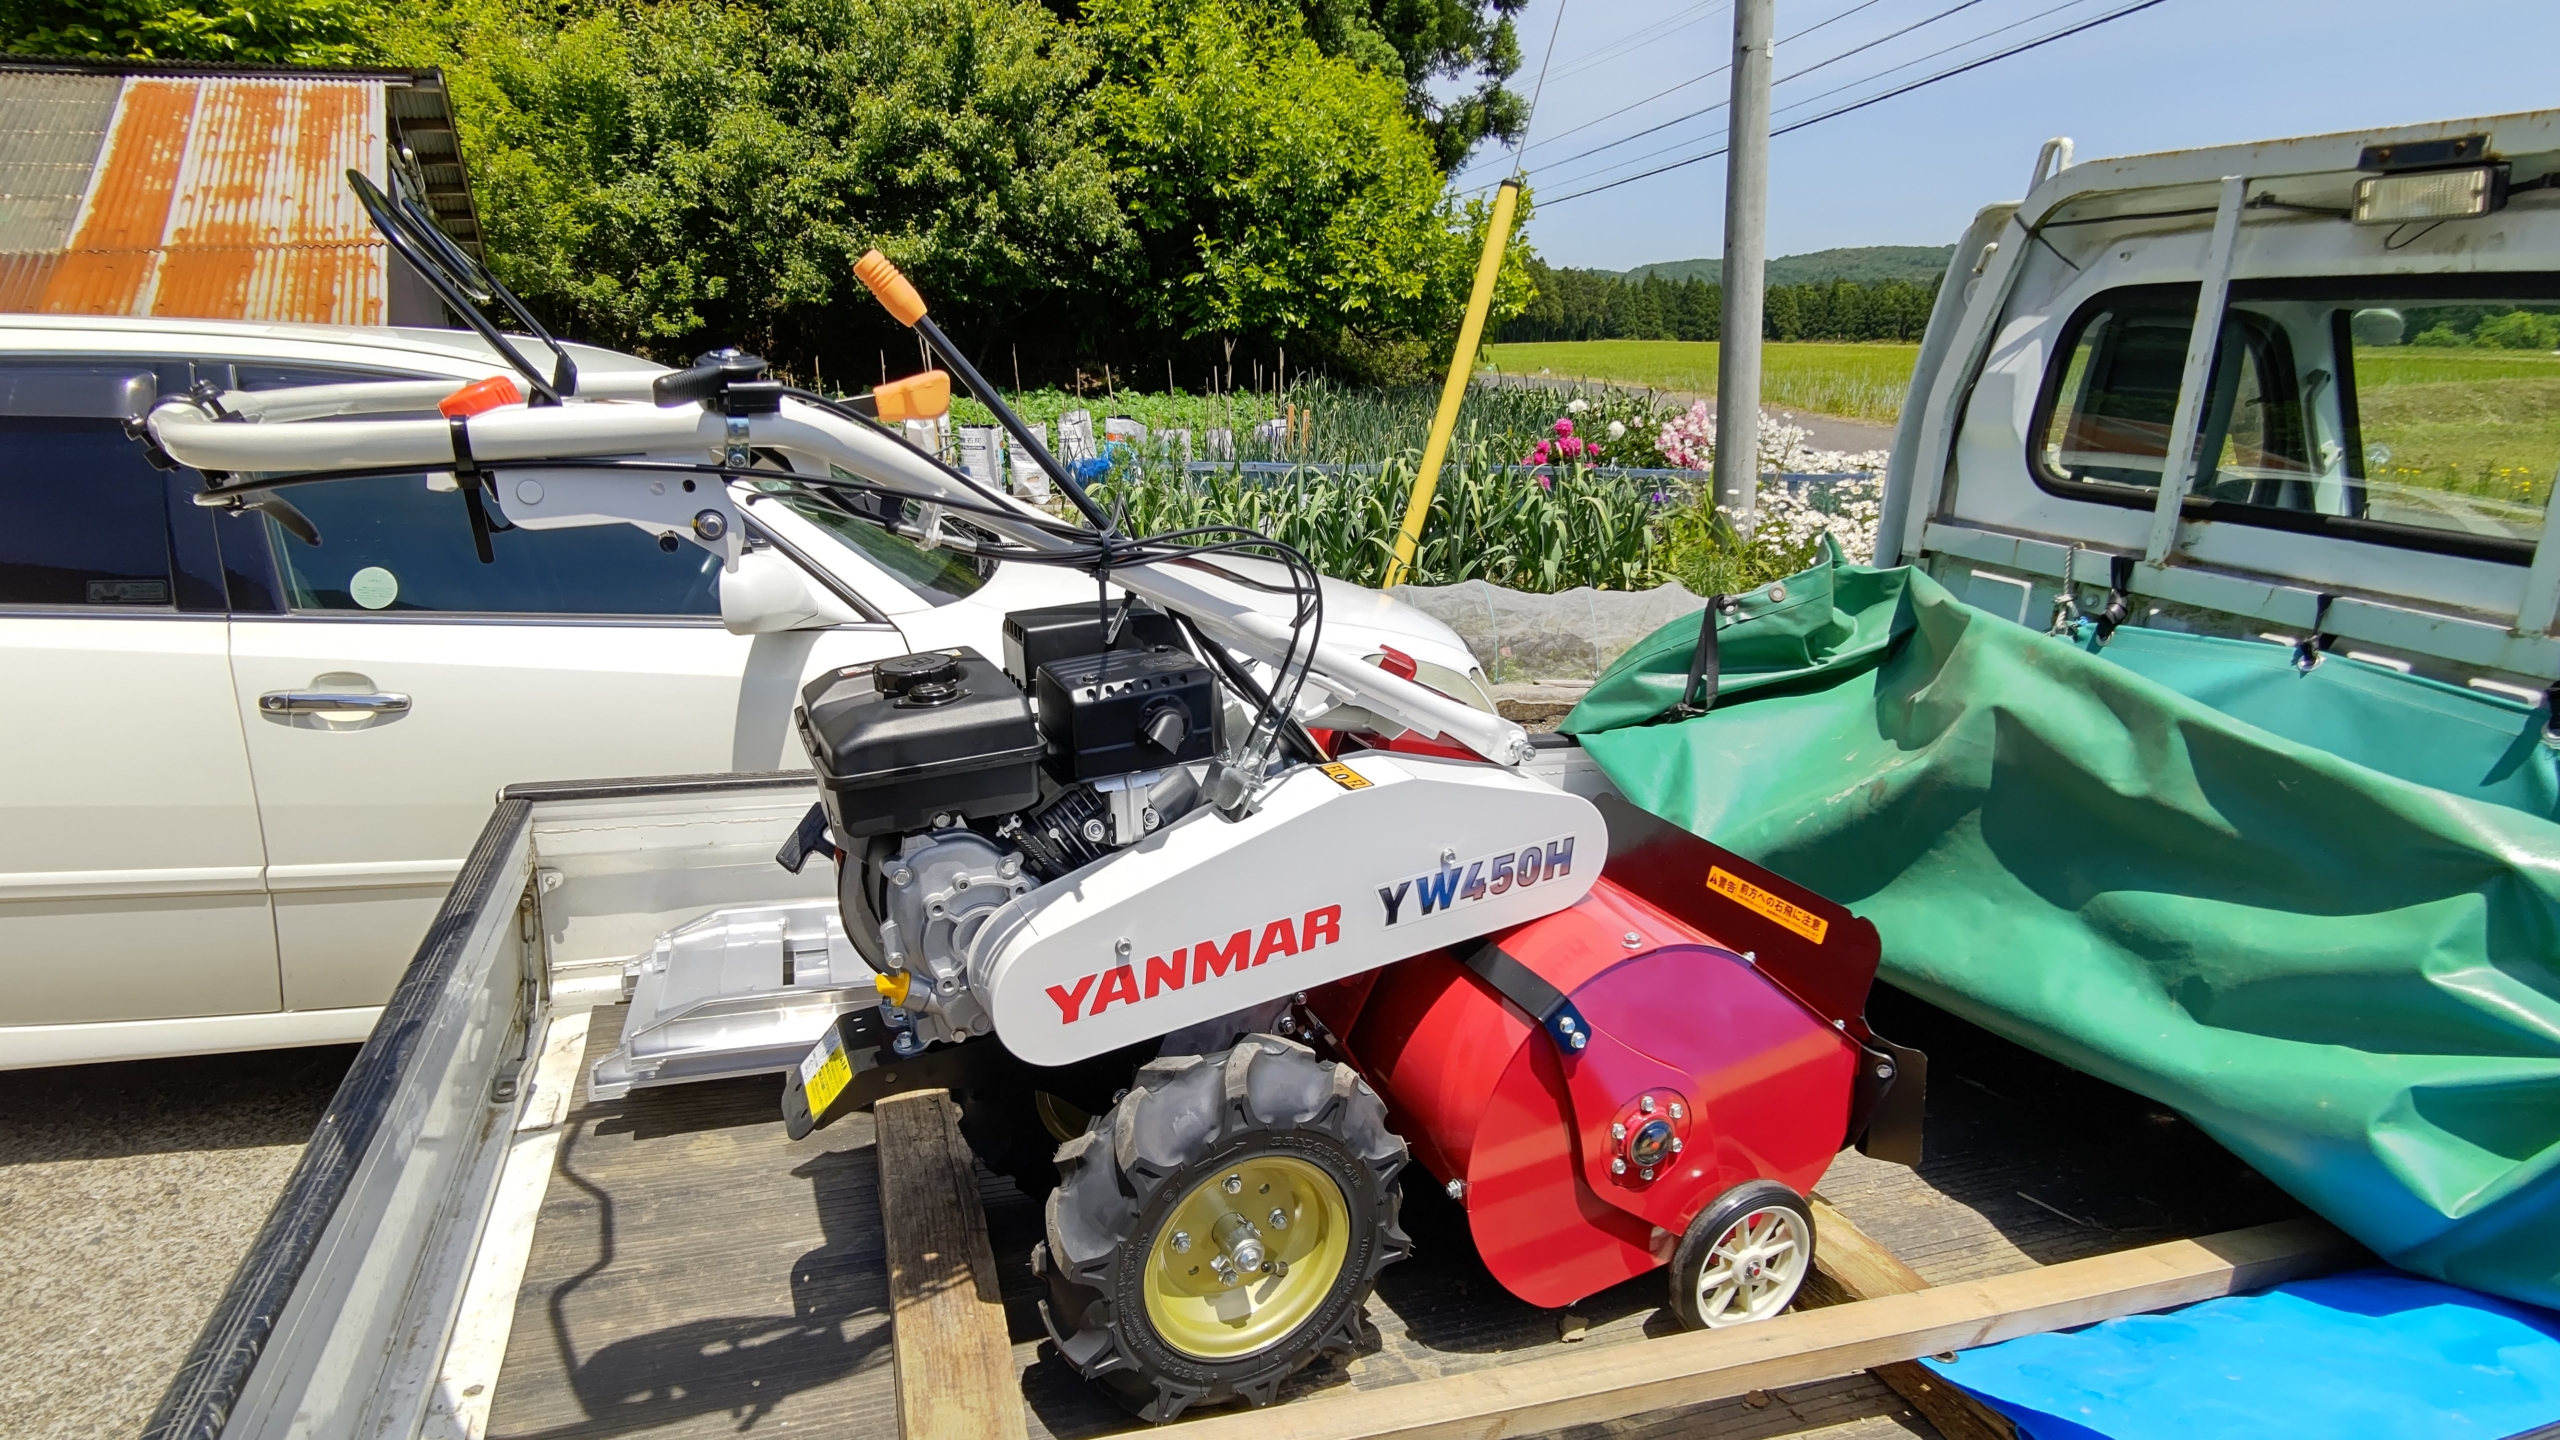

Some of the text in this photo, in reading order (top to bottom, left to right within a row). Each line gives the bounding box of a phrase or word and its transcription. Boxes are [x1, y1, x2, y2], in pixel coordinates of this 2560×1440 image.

[1326, 765, 1344, 773] F1
[1347, 779, 1366, 787] F2
[1376, 837, 1575, 927] YW450H
[1718, 875, 1737, 894] 警告
[1739, 882, 1822, 932] 前方への石飛に注意
[1045, 903, 1342, 1025] YANMAR
[1344, 1236, 1370, 1295] TRACTION
